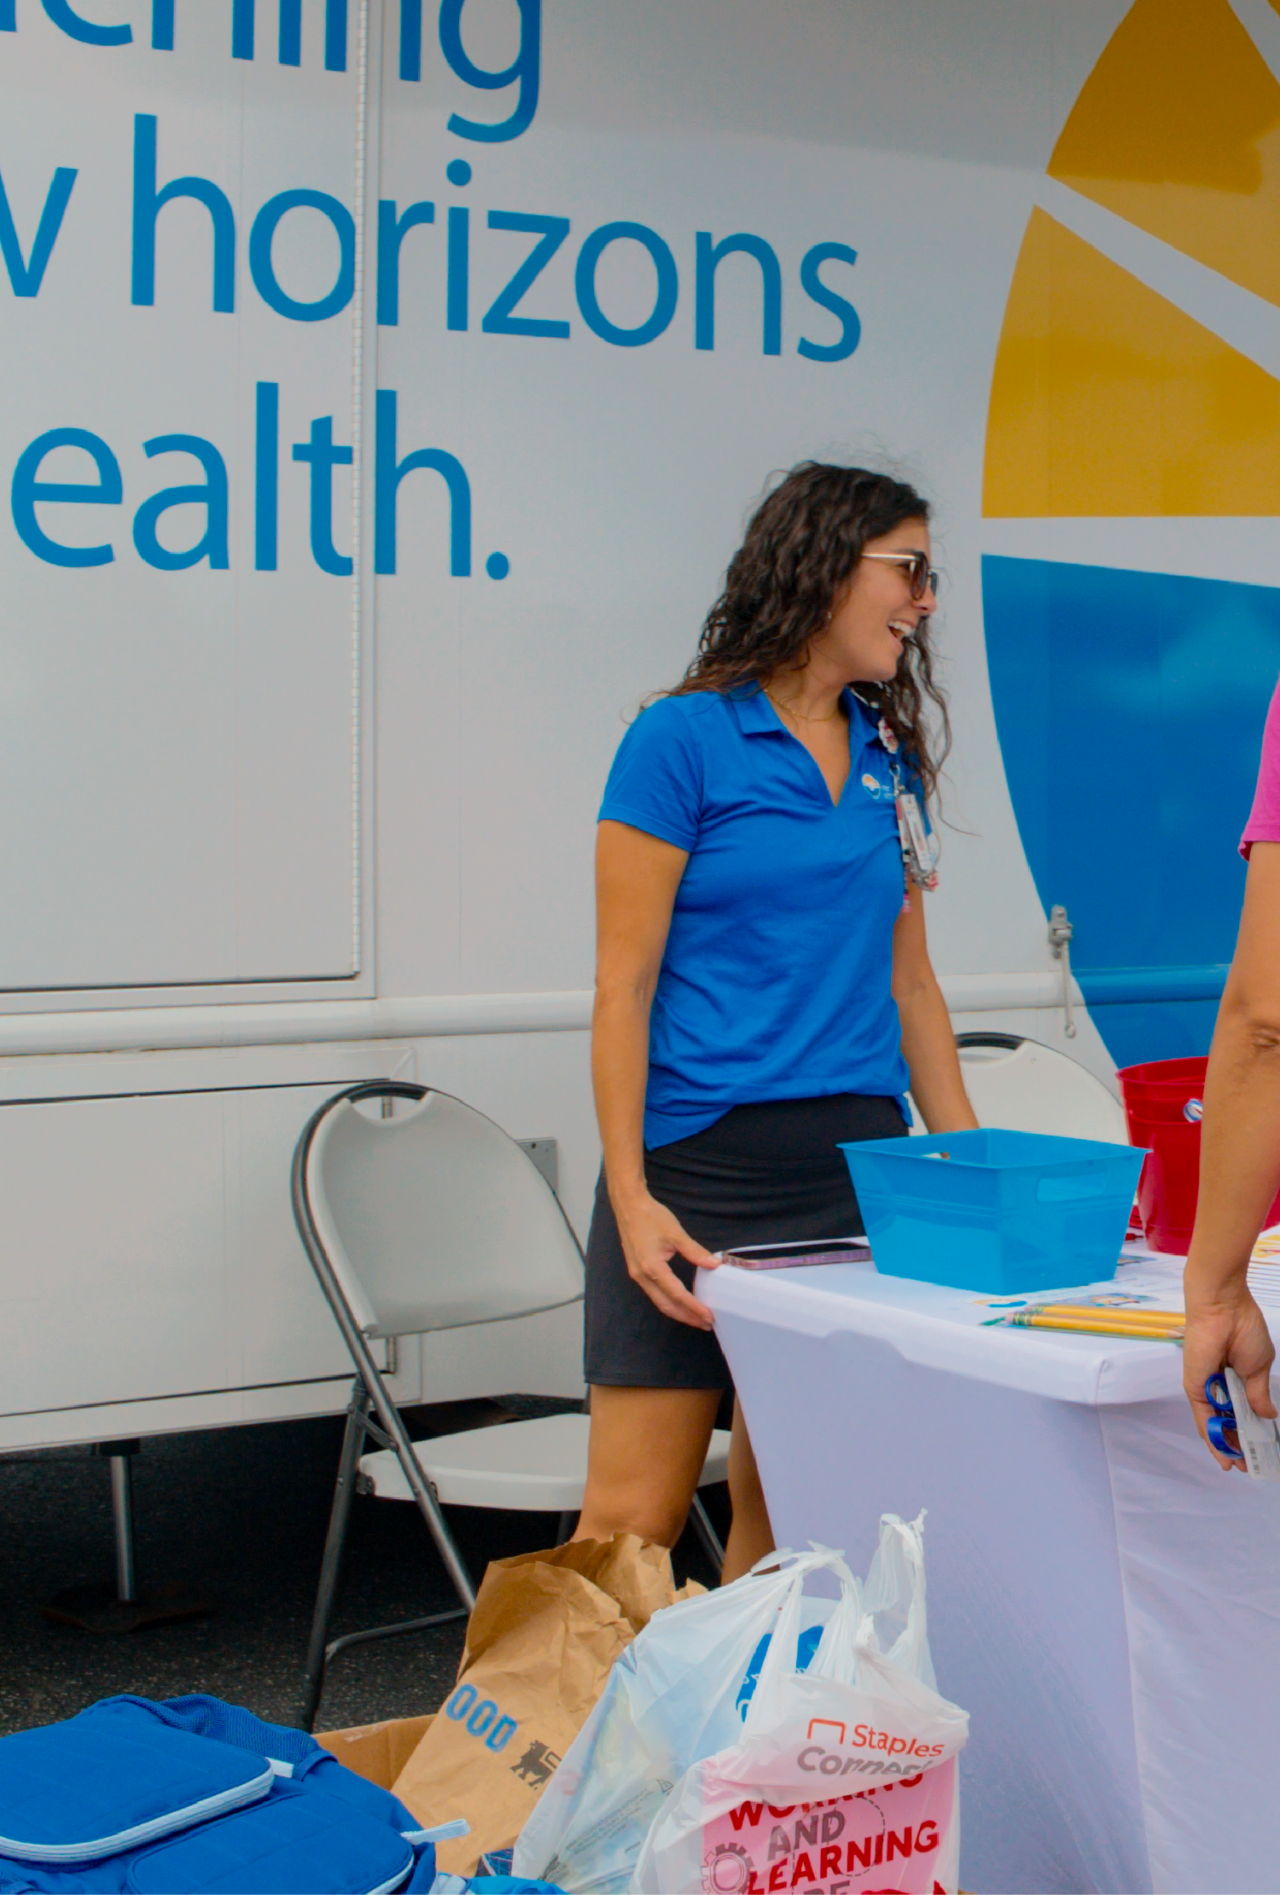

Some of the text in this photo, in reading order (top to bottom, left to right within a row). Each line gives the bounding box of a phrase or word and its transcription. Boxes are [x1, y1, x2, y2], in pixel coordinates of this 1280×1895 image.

[131, 112, 861, 363] horizons
[10, 381, 510, 580] ealth.
[852, 1724, 945, 1757] Staples
[747, 1820, 940, 1895] LEARNING
[767, 1810, 846, 1862] AND
